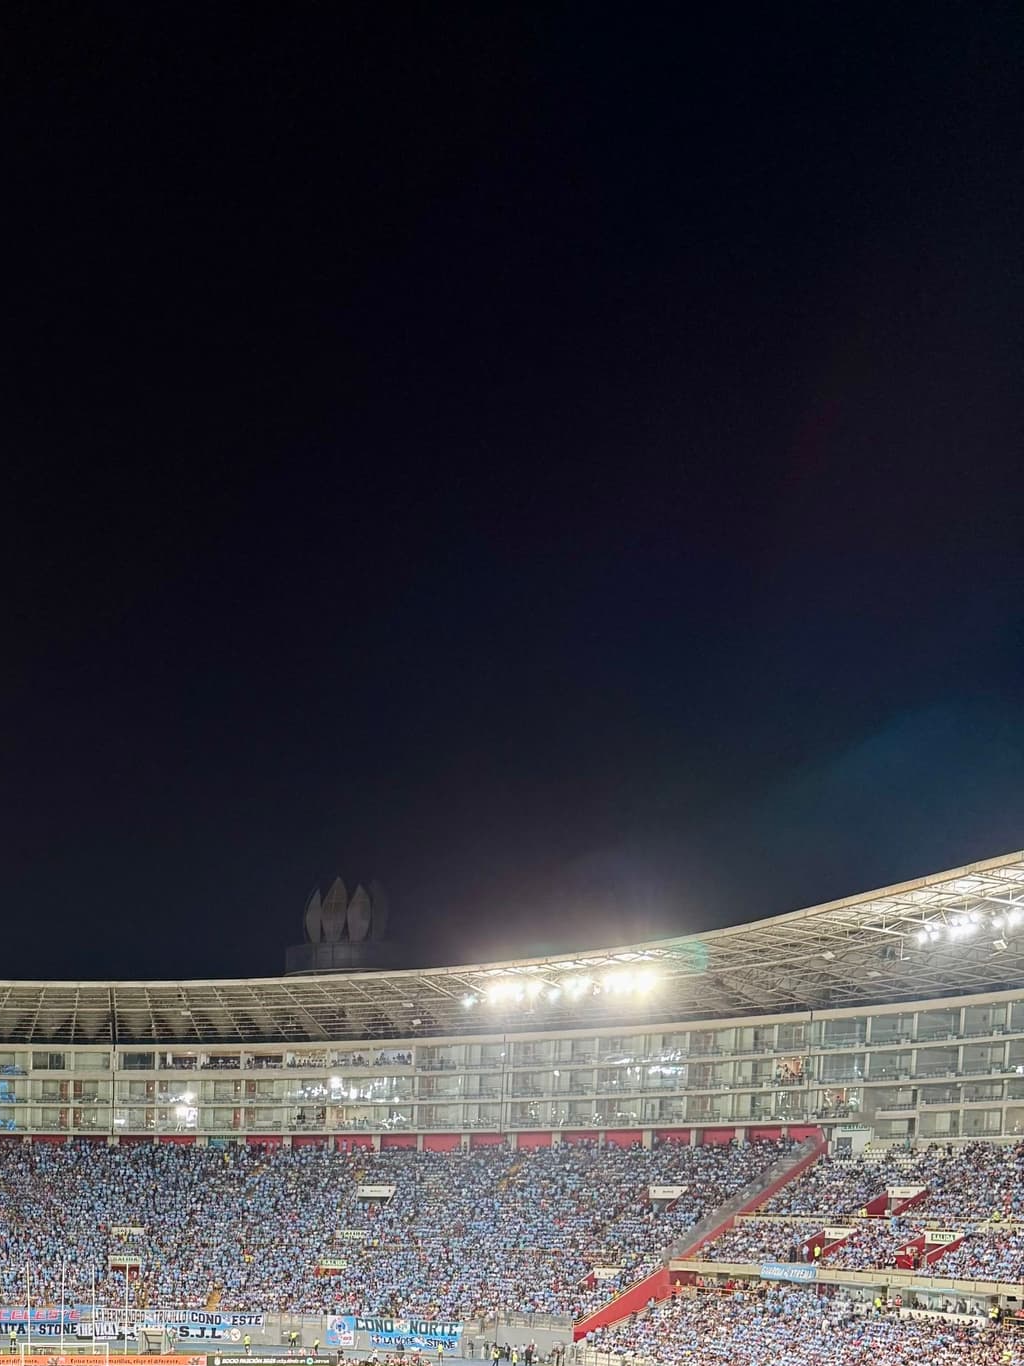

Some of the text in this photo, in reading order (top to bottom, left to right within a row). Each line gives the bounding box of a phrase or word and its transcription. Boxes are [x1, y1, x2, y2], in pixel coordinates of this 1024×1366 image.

[0, 1308, 81, 1320] CELESTE
[191, 1312, 262, 1326] CONO ESTE
[38, 1322, 78, 1335] STONE
[356, 1319, 459, 1337] CONO NORTE
